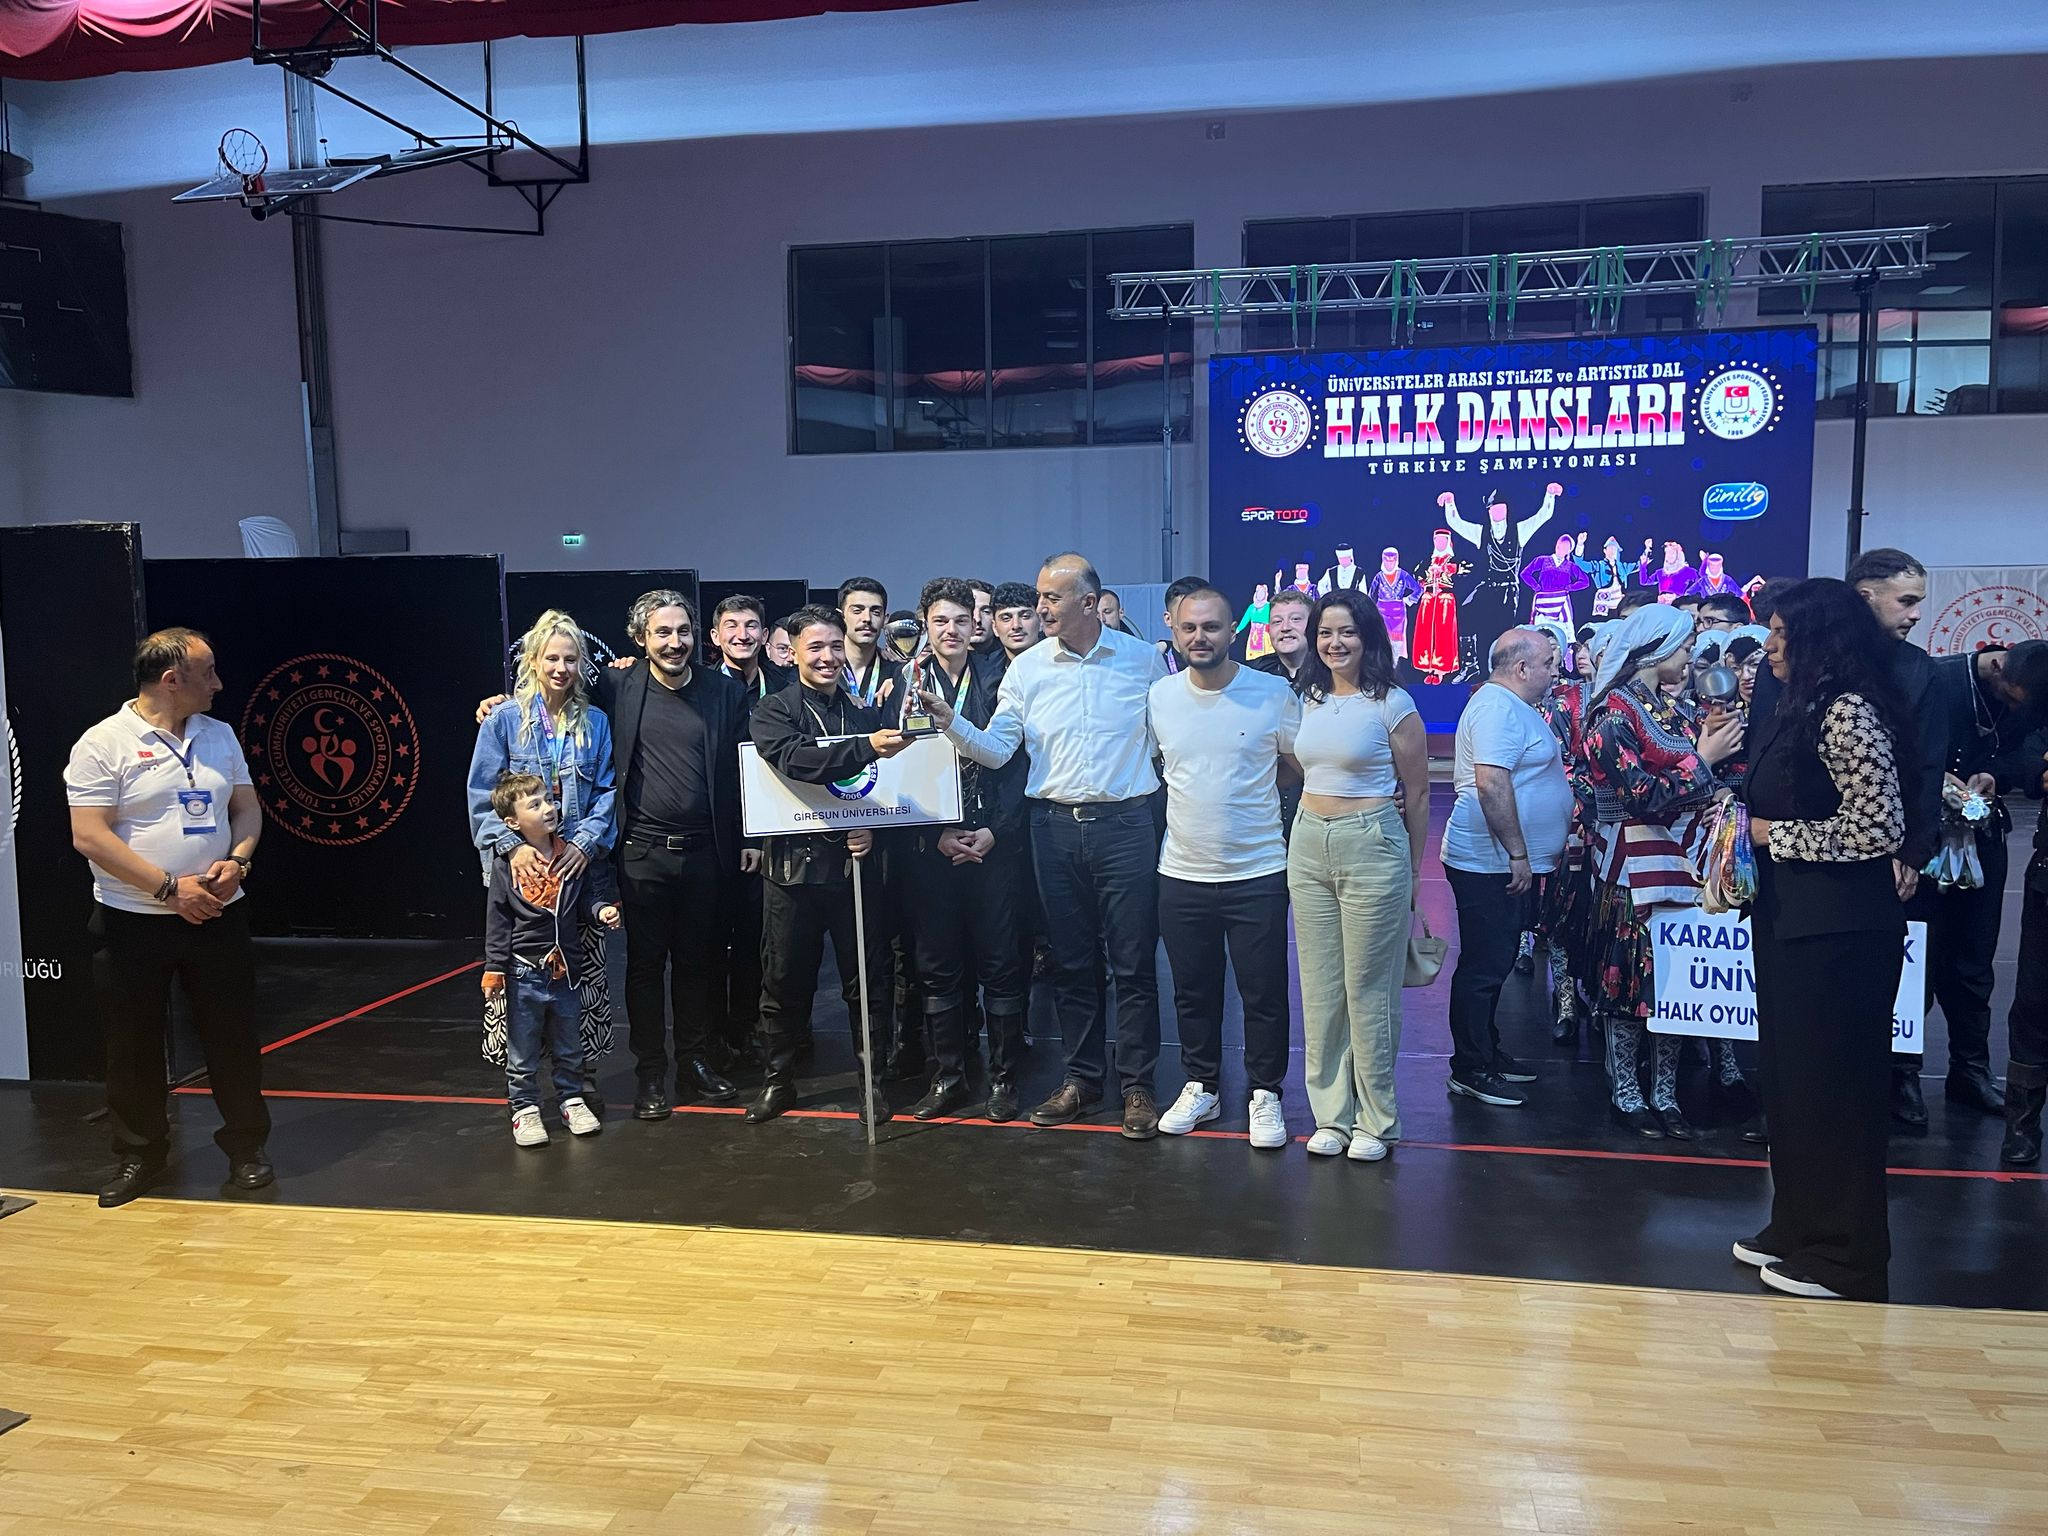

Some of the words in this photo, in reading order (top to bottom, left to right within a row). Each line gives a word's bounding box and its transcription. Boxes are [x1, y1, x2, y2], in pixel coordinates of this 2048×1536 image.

[1447, 371, 1493, 387] ARASI
[1557, 371, 1573, 382] ve
[1652, 362, 1684, 378] DAL
[1324, 393, 1445, 458] HALK
[1456, 382, 1686, 453] DANSLARI
[1368, 457, 1466, 475] TÜRKİYE
[310, 689, 358, 707] GENÇLİK
[359, 703, 373, 720] VE
[369, 719, 386, 751] SPOR
[840, 792, 862, 800] 2006
[1659, 922, 1750, 951] KARAD
[0, 958, 61, 979] RLÜĞÜ
[1690, 957, 1757, 992] ÜNİV
[1657, 1001, 1703, 1022] HALK
[1709, 1004, 1759, 1026] OYUN
